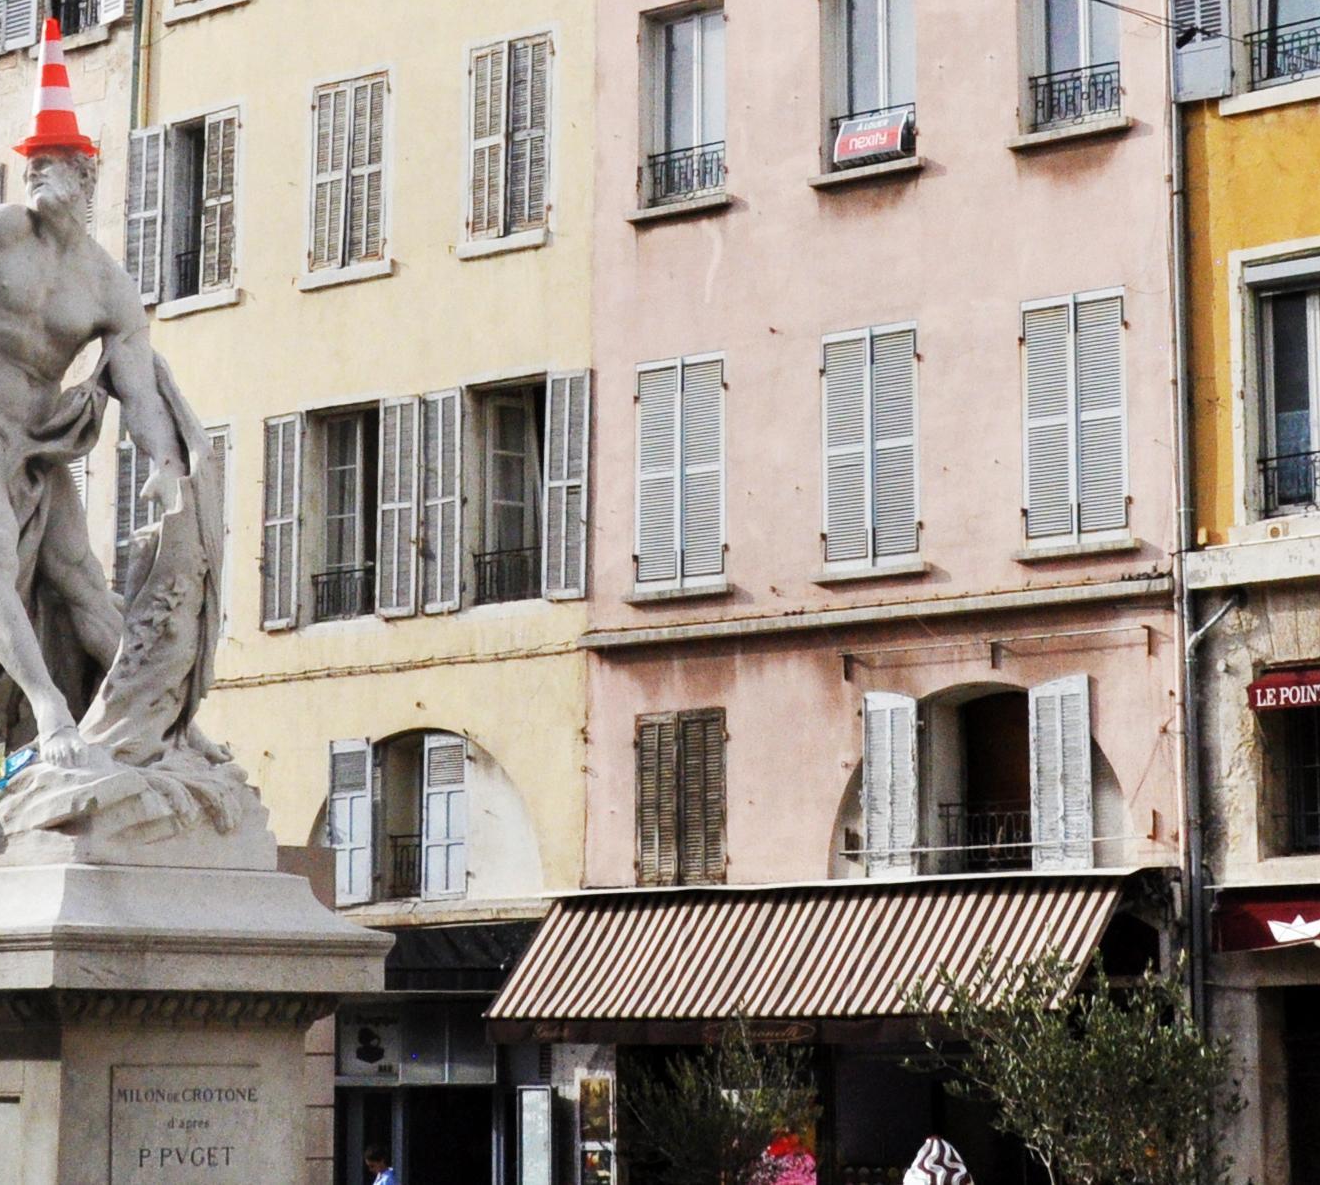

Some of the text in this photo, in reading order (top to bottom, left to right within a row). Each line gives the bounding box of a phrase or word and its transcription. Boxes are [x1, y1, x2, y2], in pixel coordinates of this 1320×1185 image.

[849, 132, 888, 150] nexity
[1255, 688, 1277, 707] LE
[117, 1088, 165, 1102] MILON
[181, 1088, 259, 1103] CROTONE
[159, 1146, 235, 1168] PVGET
